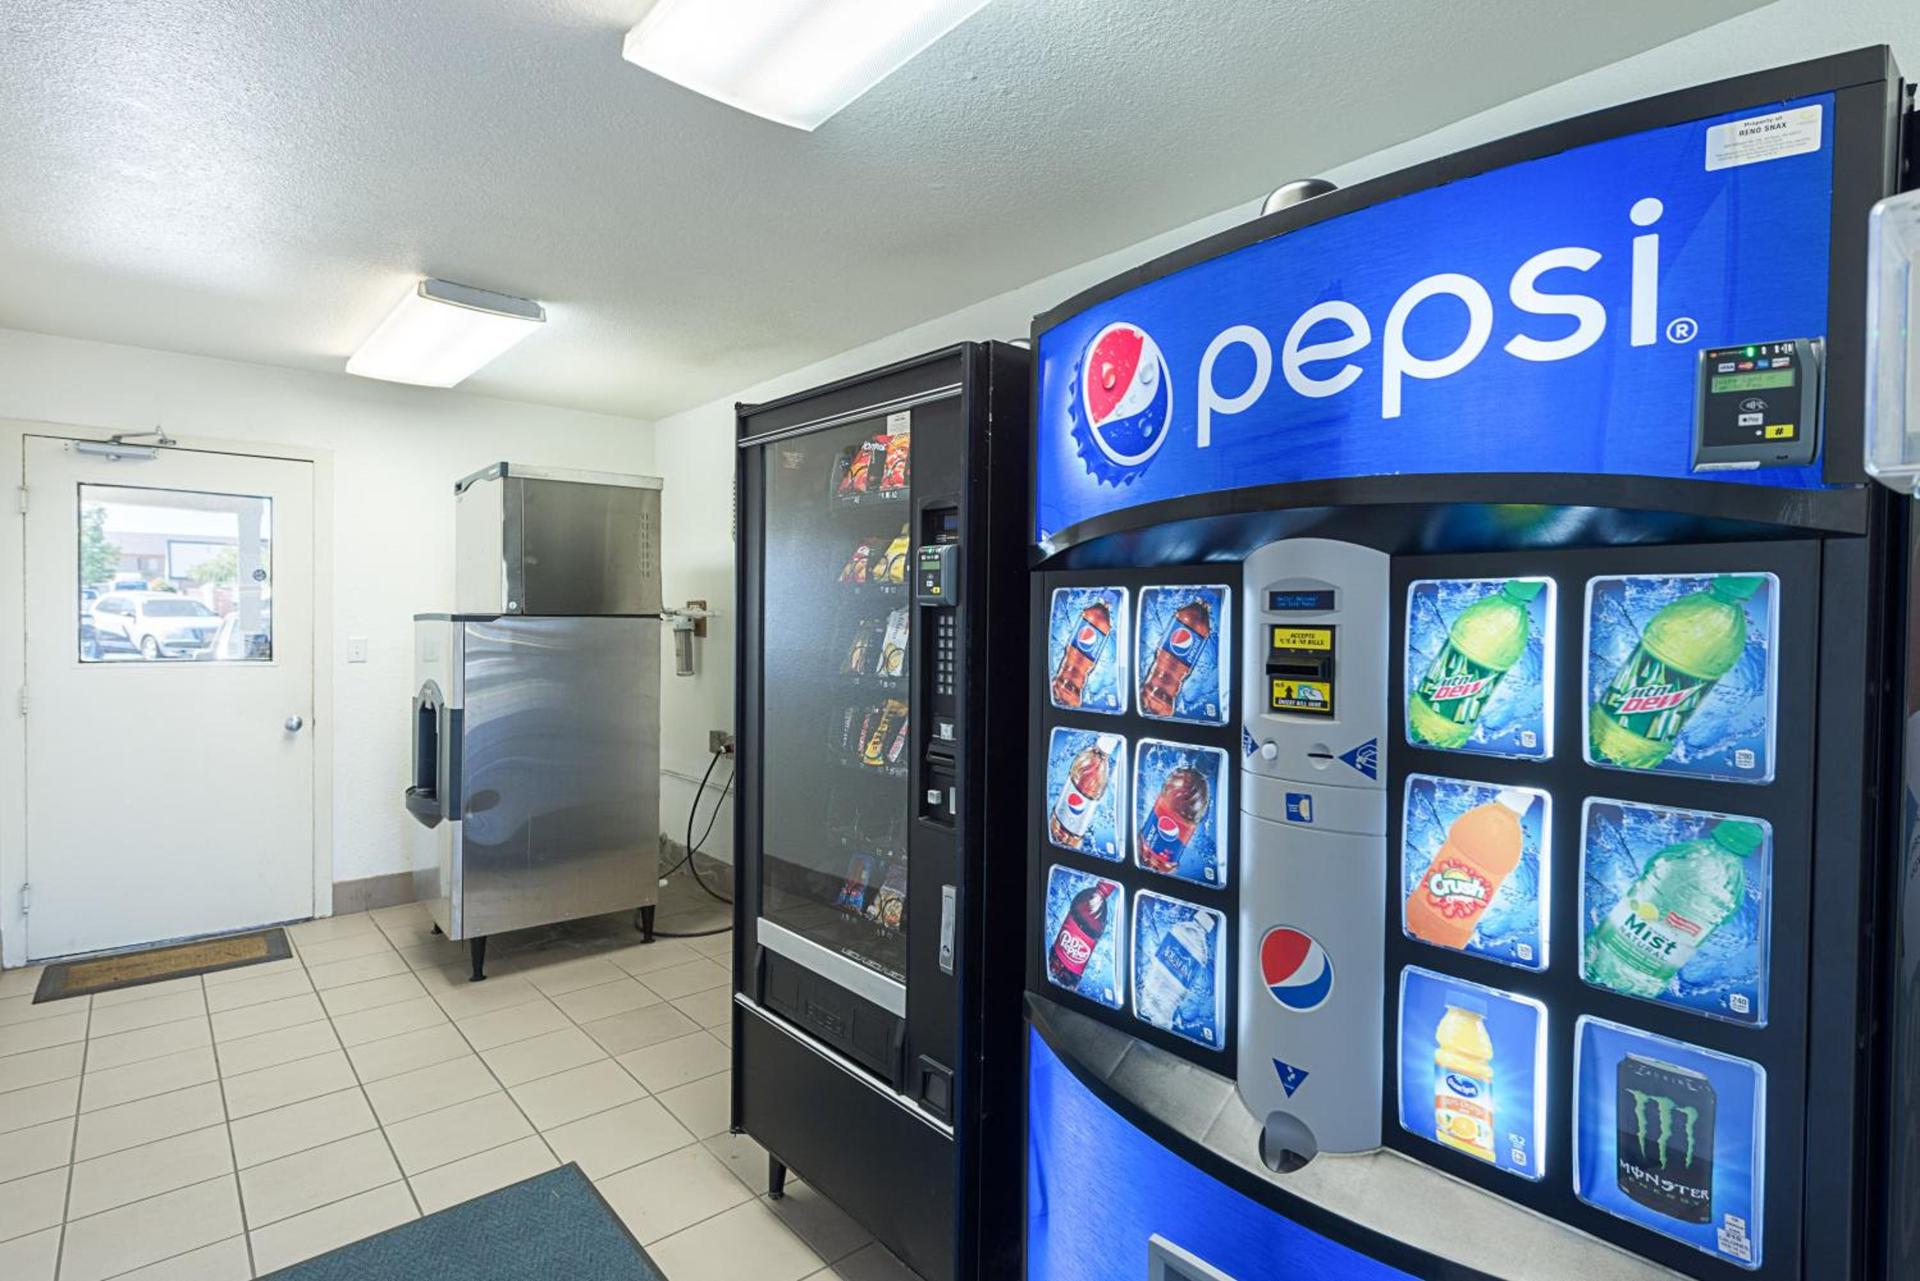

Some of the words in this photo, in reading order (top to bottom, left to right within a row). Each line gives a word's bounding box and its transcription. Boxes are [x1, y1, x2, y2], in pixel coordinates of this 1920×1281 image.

[1739, 127, 1762, 136] RENO
[1764, 122, 1787, 132] SNAX
[1197, 197, 1664, 447] pepsi
[1430, 872, 1486, 899] Crush
[1624, 913, 1677, 955] Mist
[1619, 1158, 1710, 1201] MONSTER
